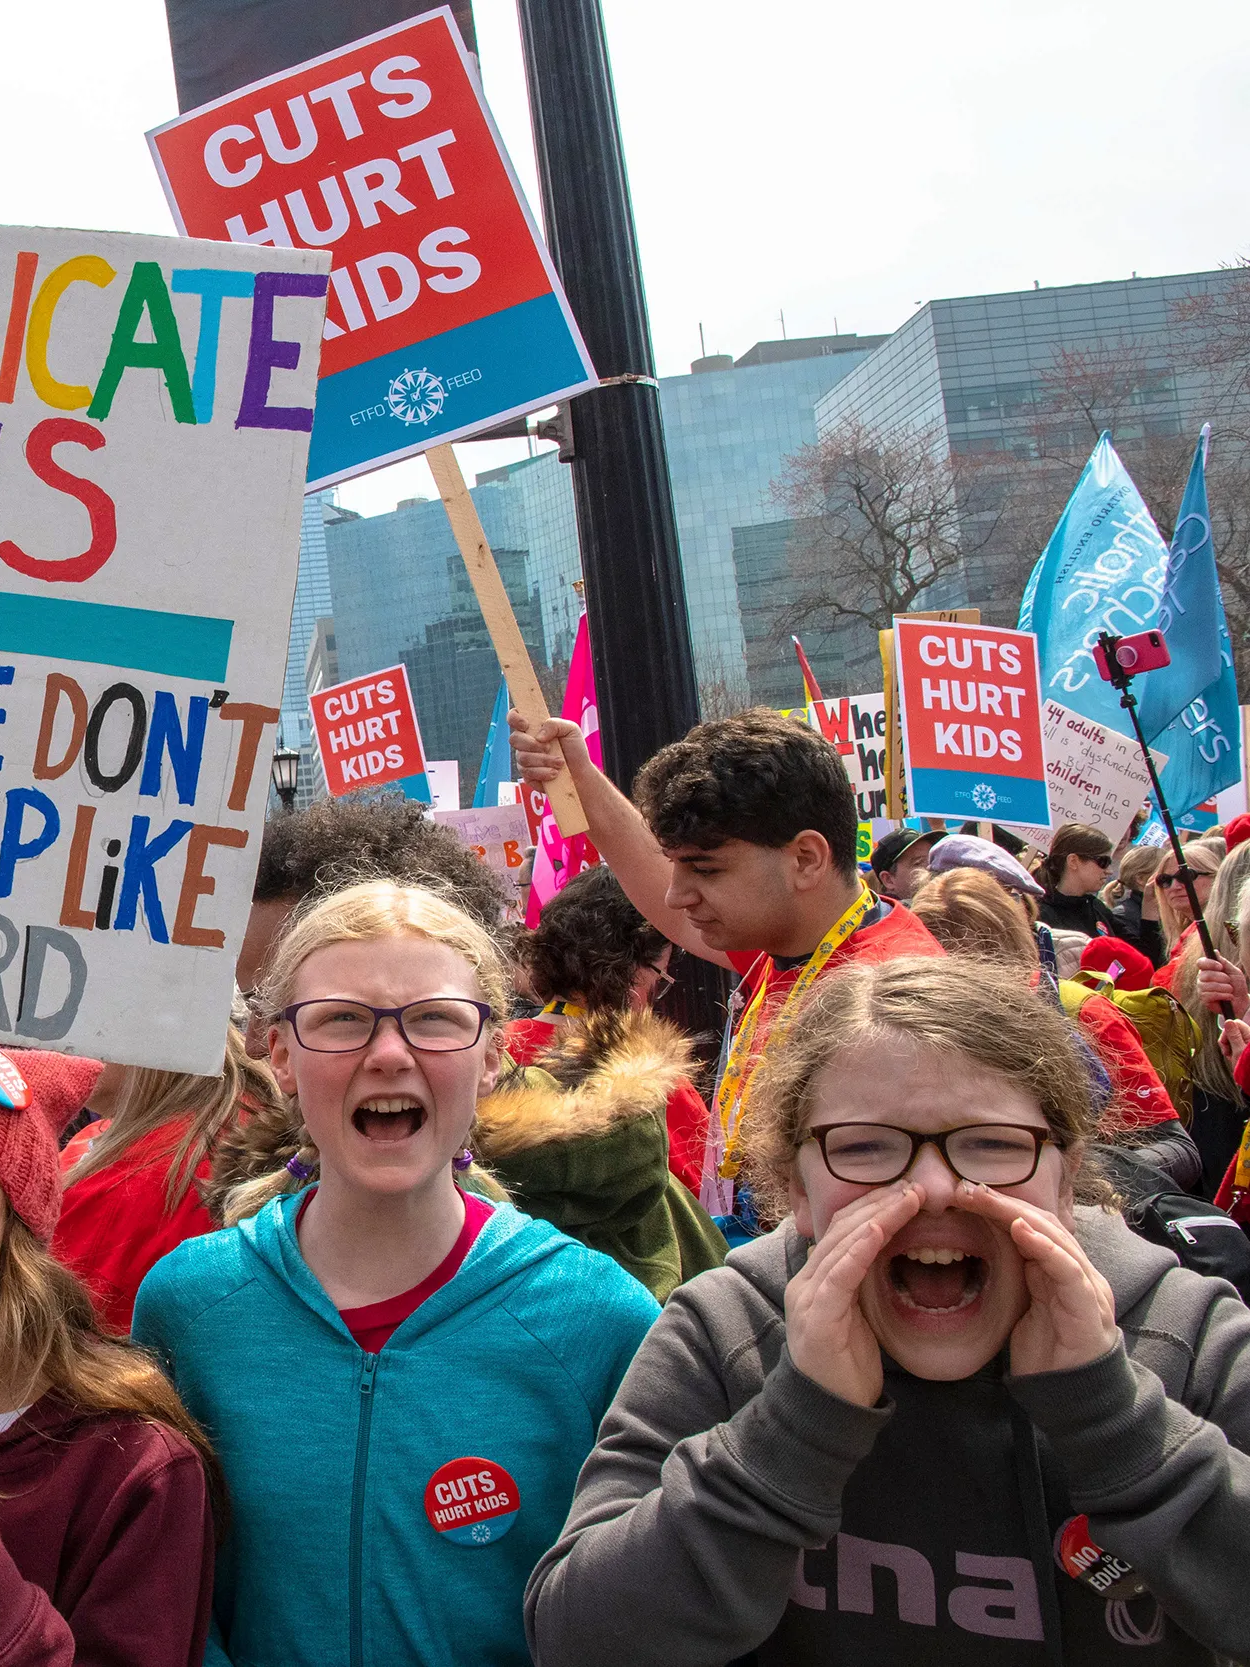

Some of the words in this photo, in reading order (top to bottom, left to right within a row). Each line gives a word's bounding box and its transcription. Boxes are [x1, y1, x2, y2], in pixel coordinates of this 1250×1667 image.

[203, 55, 432, 189] CUTS
[224, 129, 457, 248] HURT
[321, 226, 481, 340] IDS
[350, 403, 386, 426] ETFO
[446, 368, 483, 391] FEEO
[919, 635, 1022, 675] CUTS
[324, 680, 396, 721] CUTS
[921, 678, 1026, 718] HURT
[33, 672, 280, 812] DON'T
[328, 710, 401, 753] HURT
[934, 722, 1022, 762] KIDS
[1047, 705, 1065, 724] 44
[1066, 720, 1105, 745] adults
[1115, 742, 1127, 755] in
[340, 744, 405, 783] KIDS
[1047, 760, 1101, 795] children
[1106, 791, 1117, 802] in
[1122, 799, 1130, 807] a
[434, 1470, 496, 1505] CUTS
[434, 1502, 472, 1524] HURT
[474, 1492, 510, 1513] KIDS
[1070, 1546, 1099, 1571] NO
[1101, 1554, 1112, 1564] to
